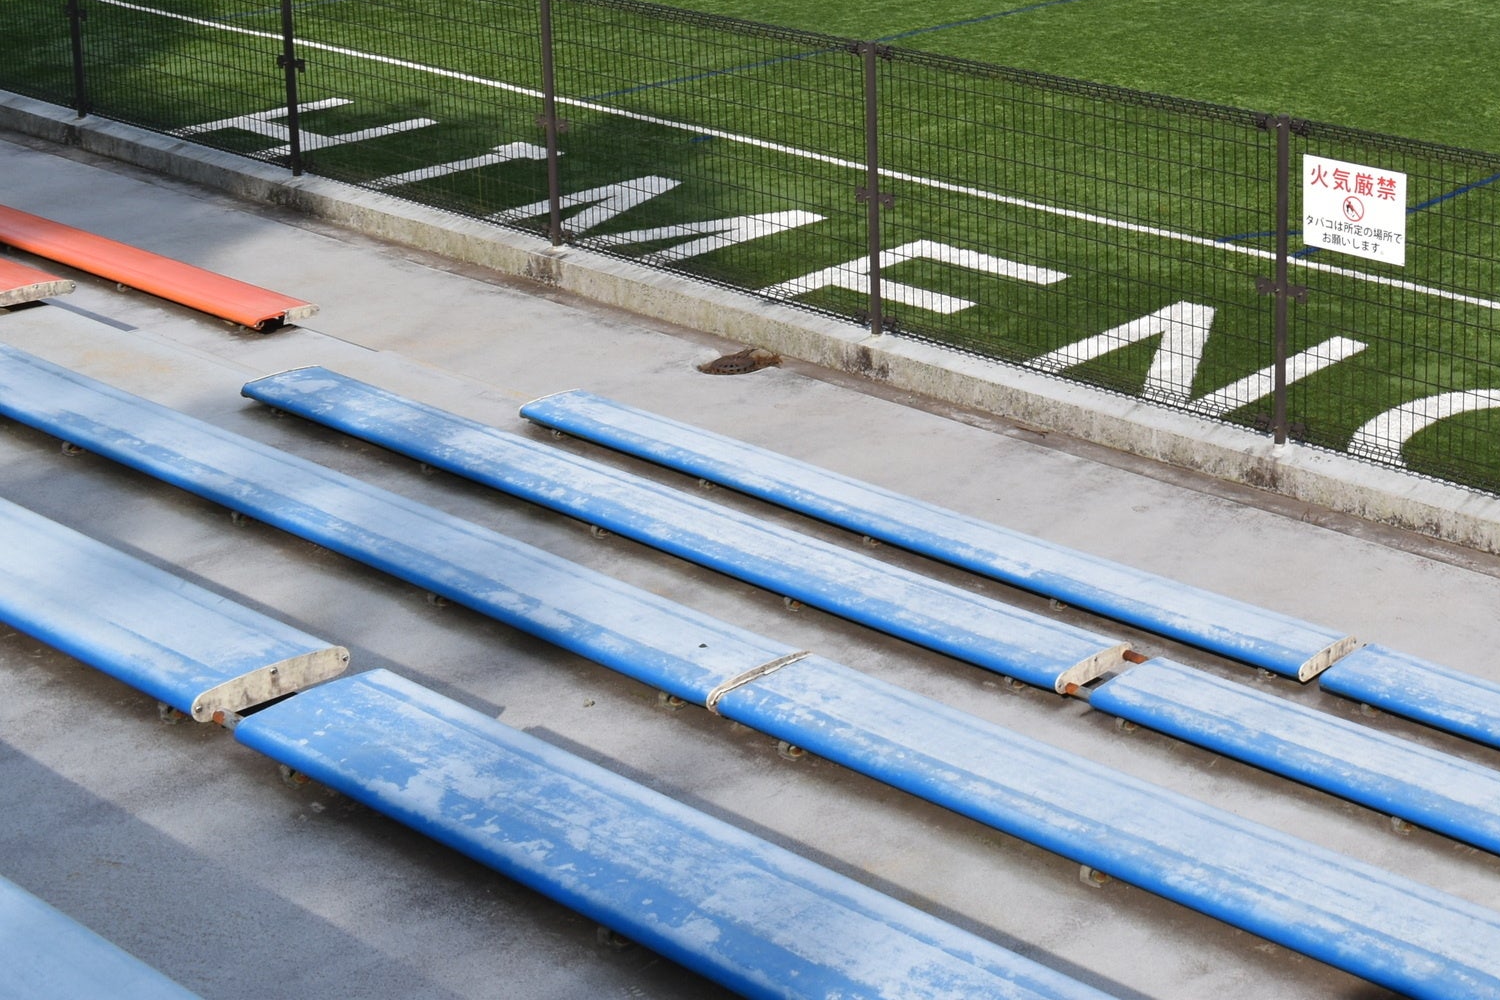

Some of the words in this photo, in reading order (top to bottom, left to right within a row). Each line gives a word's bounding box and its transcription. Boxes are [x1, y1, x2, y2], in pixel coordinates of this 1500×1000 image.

[1310, 164, 1397, 201] 火気厳禁
[1306, 215, 1403, 244] タバコは所定の場所で
